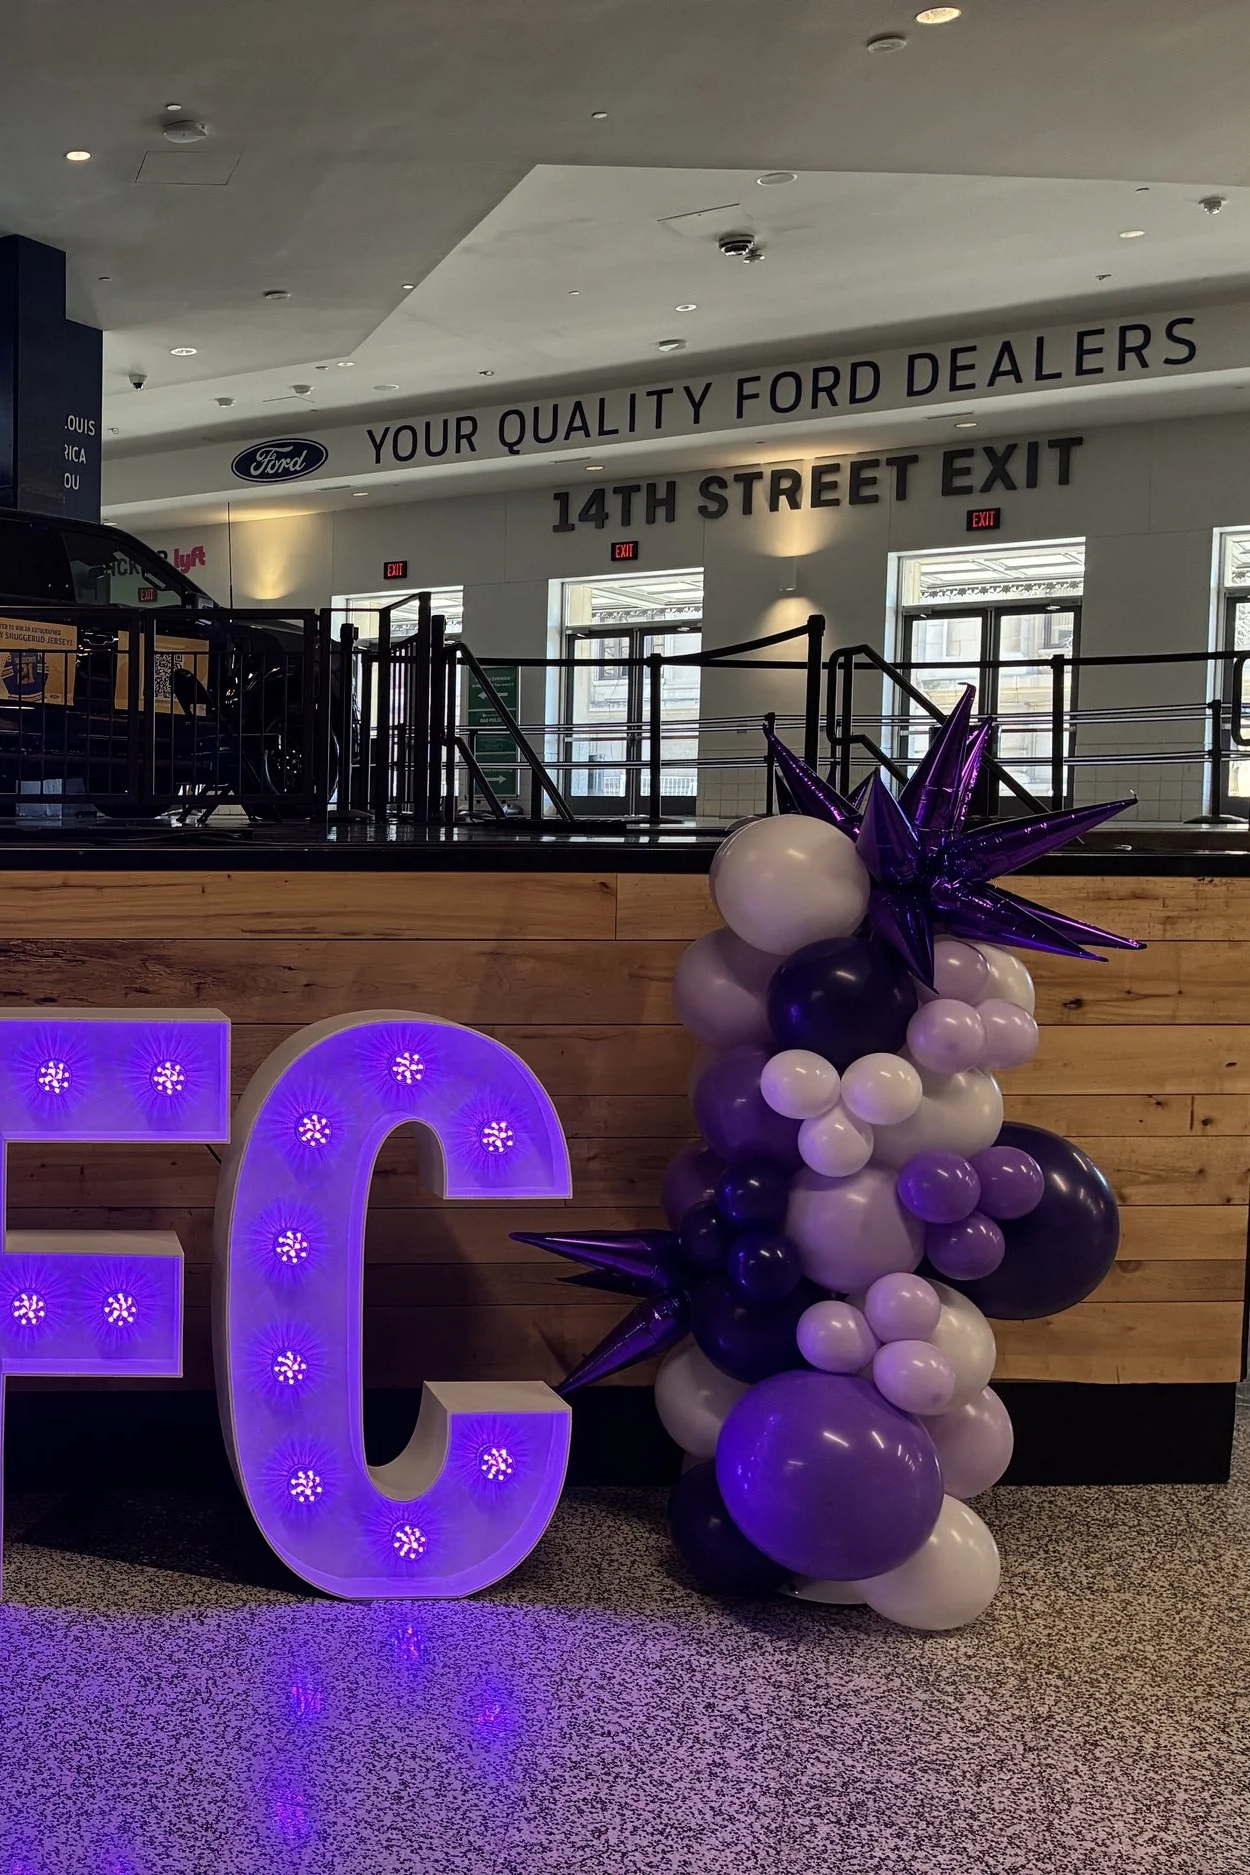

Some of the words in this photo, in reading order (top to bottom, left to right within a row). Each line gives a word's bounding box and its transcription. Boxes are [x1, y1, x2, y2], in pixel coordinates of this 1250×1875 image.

[366, 415, 479, 465] YOUR
[497, 381, 714, 456] QUALITY
[735, 359, 882, 420] FORD
[905, 316, 1198, 398] DEALERS
[64, 414, 96, 437] OUIS
[551, 479, 678, 534] 14TH
[697, 454, 919, 520] STREET
[940, 435, 1085, 498] EXIT
[971, 510, 996, 529] EXIT
[173, 545, 206, 574] lyft
[614, 542, 635, 559] EXIT
[386, 562, 405, 578] EXIT
[140, 588, 155, 602] EXIT
[5, 632, 45, 644] SNUGGERUD
